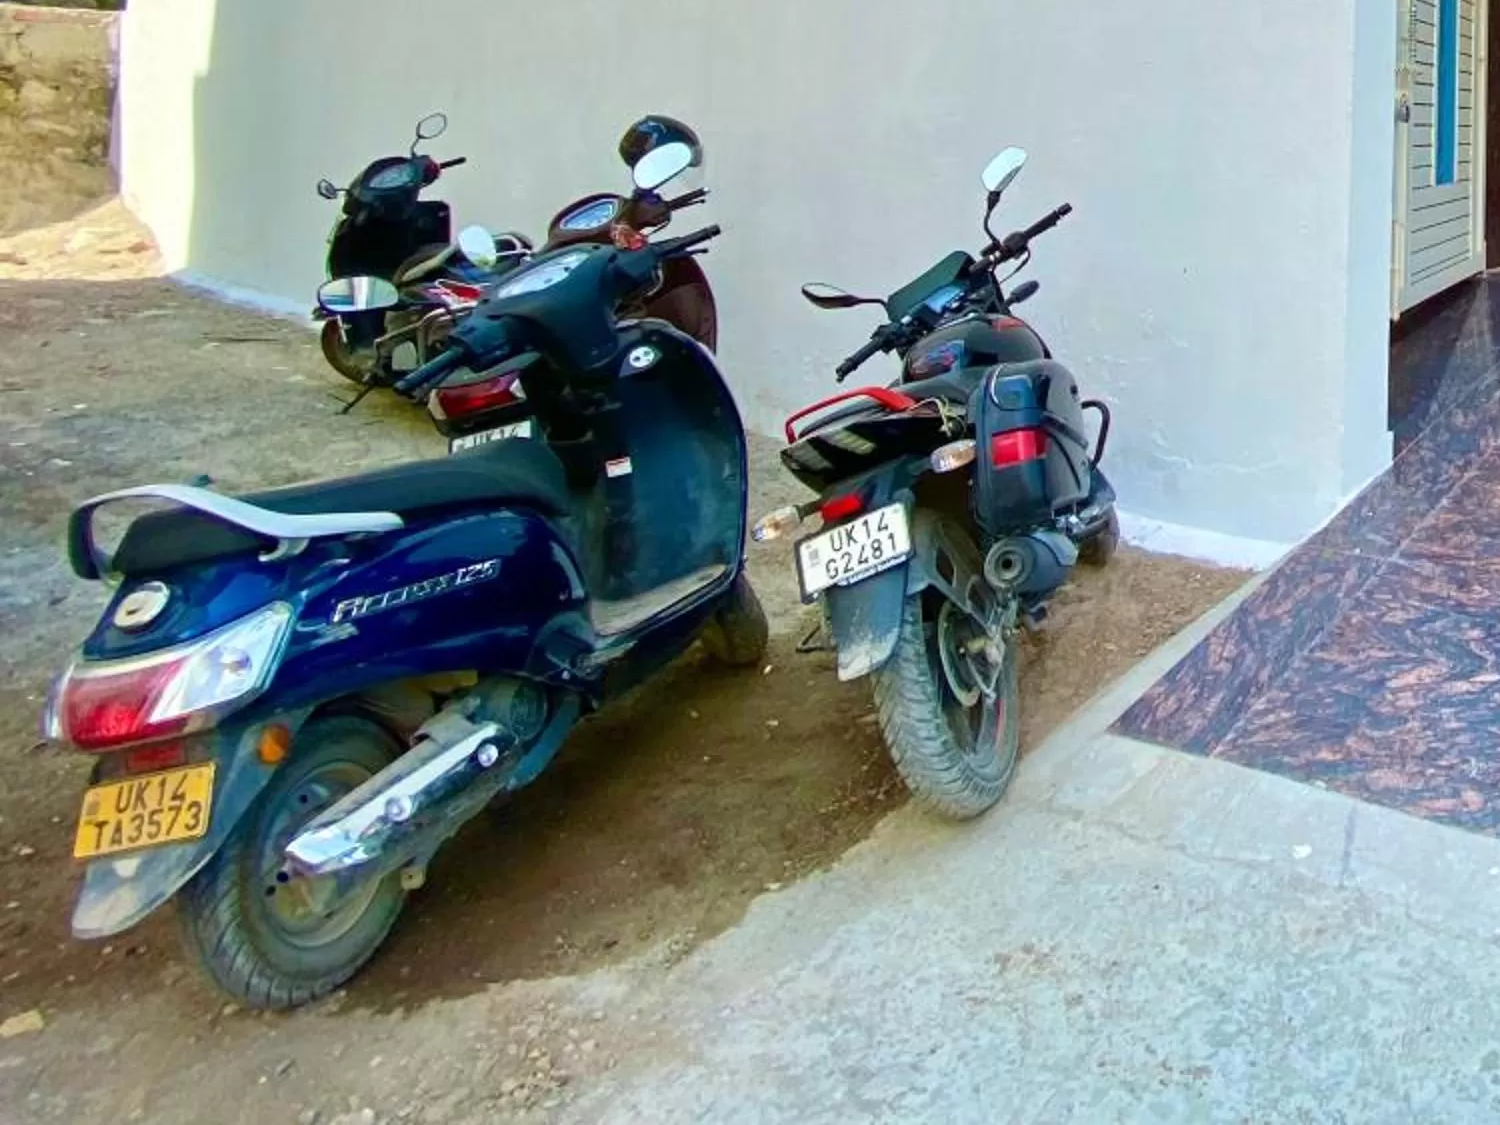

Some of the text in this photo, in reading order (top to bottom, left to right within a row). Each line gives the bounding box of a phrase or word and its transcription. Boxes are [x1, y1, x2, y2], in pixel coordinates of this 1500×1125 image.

[825, 533, 897, 580] G2481
[115, 773, 188, 814] UK14
[91, 800, 202, 850] TA3573
